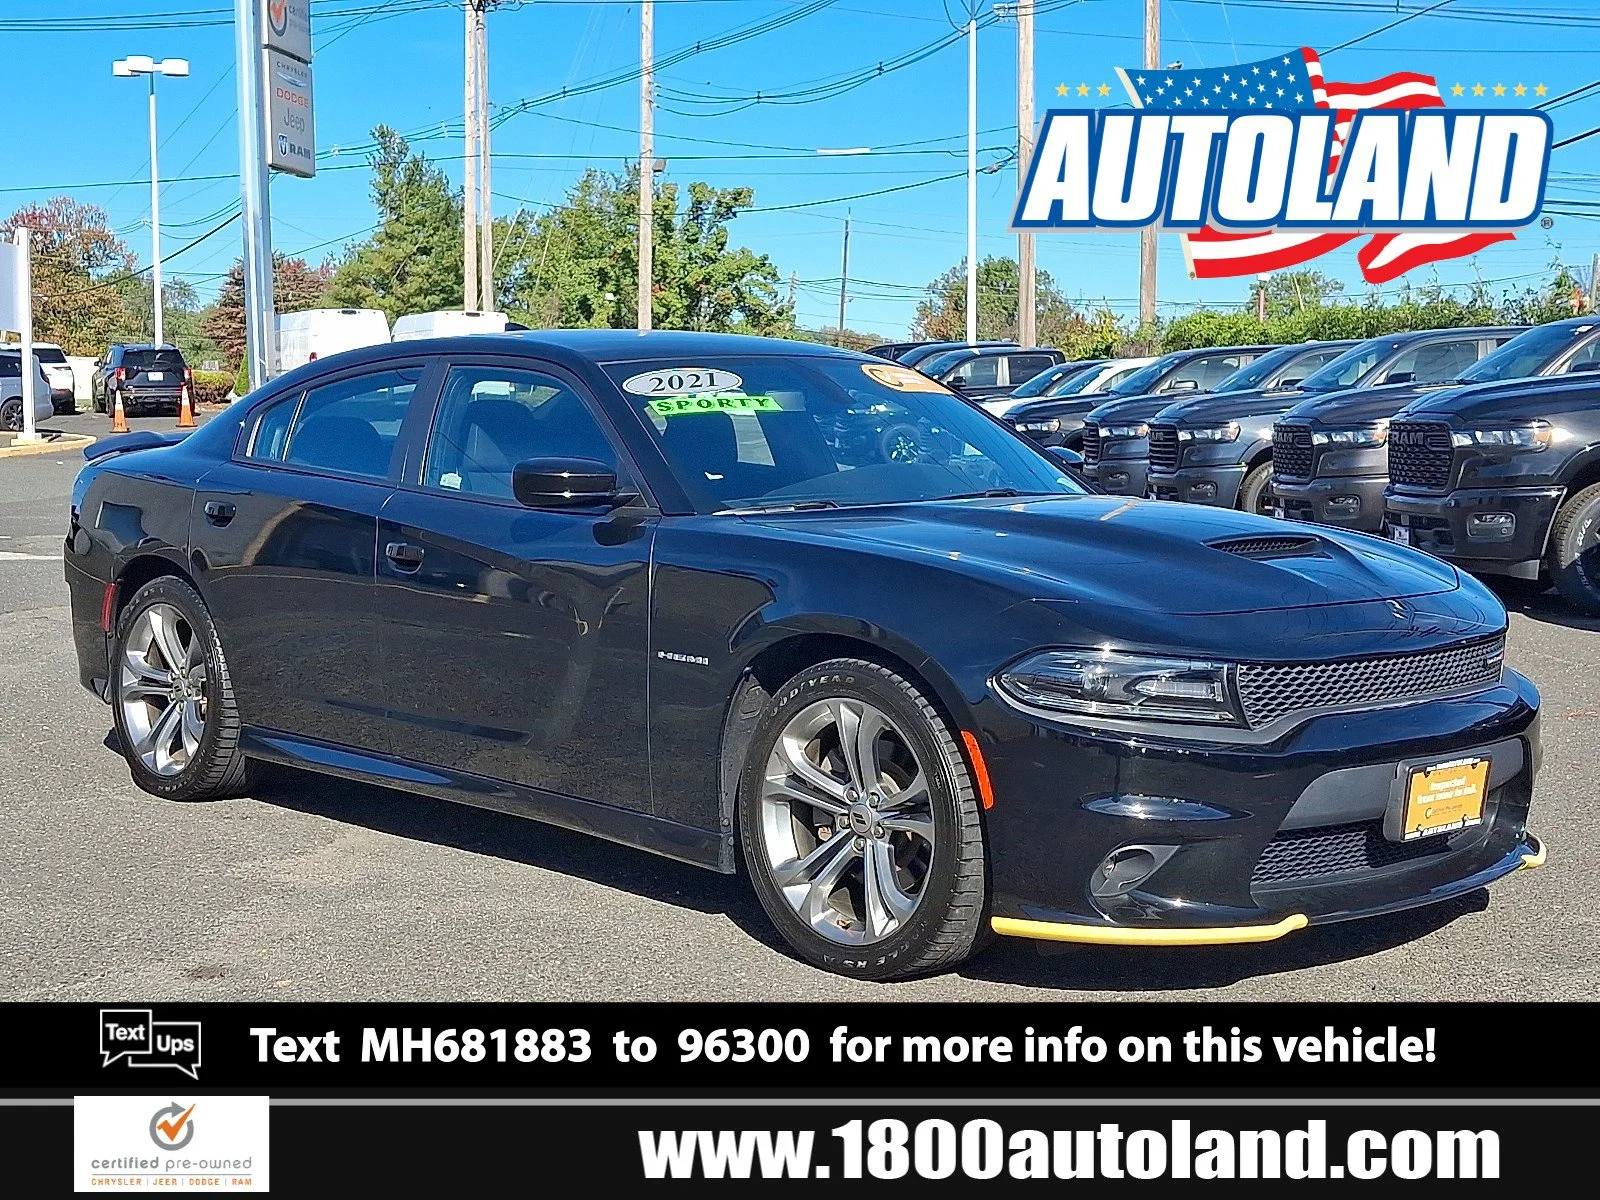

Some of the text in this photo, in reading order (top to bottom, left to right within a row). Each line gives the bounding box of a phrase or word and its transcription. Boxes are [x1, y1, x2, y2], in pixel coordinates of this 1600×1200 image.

[276, 87, 309, 108] DODGE
[283, 107, 306, 135] Jeep
[289, 142, 311, 160] RAM
[648, 372, 719, 393] 2021
[656, 398, 770, 412] SPORTY
[1390, 431, 1424, 445] RAM
